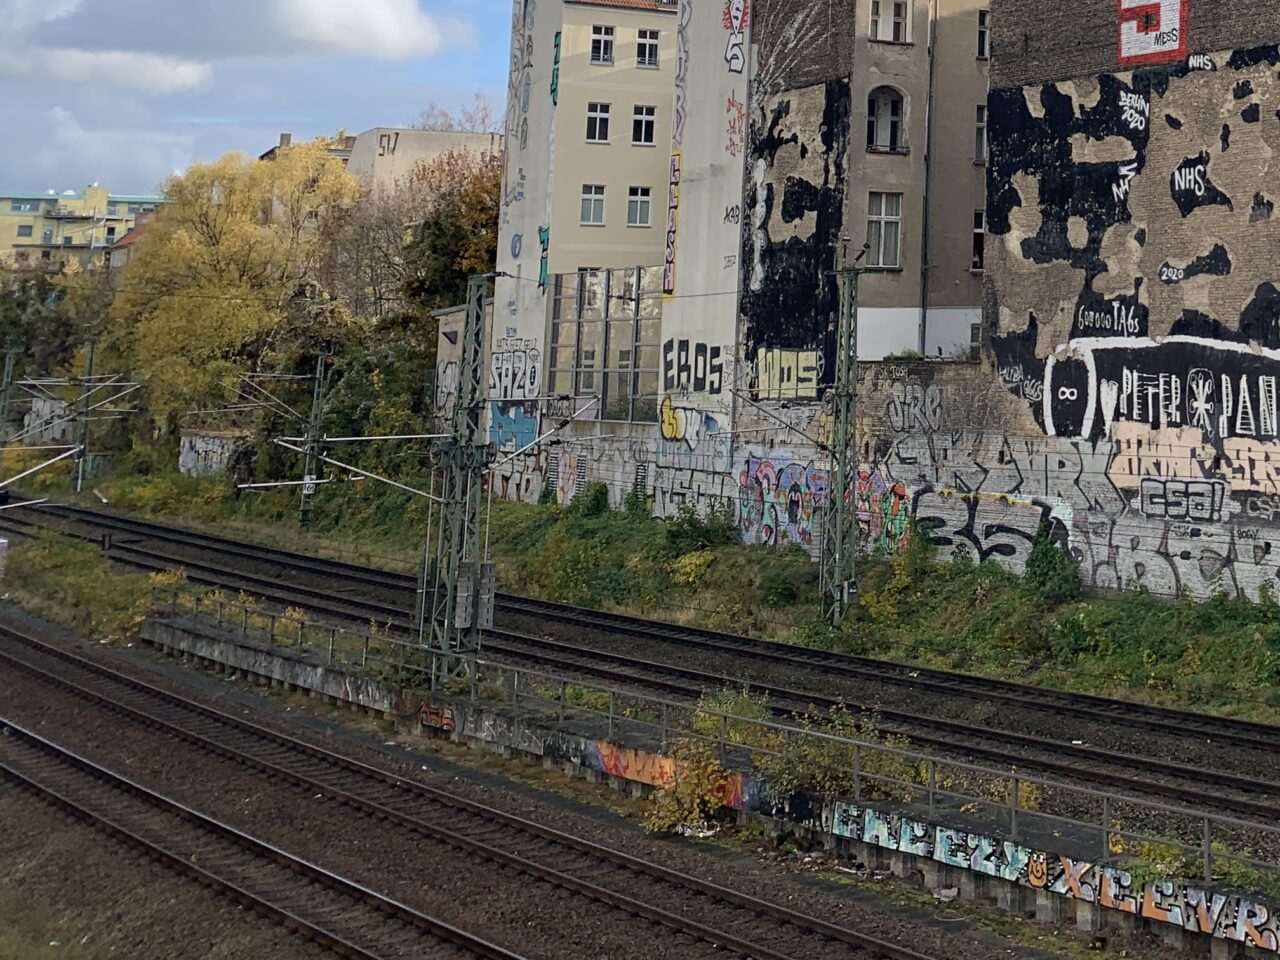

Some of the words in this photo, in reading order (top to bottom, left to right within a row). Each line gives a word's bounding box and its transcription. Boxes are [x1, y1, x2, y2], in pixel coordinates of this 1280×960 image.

[1154, 28, 1179, 46] MESS
[1188, 55, 1212, 71] NHS
[1121, 106, 1146, 131] 2020
[1174, 164, 1205, 196] NHS
[1161, 267, 1184, 280] 2020
[663, 337, 724, 395] EROS
[1120, 366, 1181, 424] PETER
[1218, 373, 1278, 439] PAN
